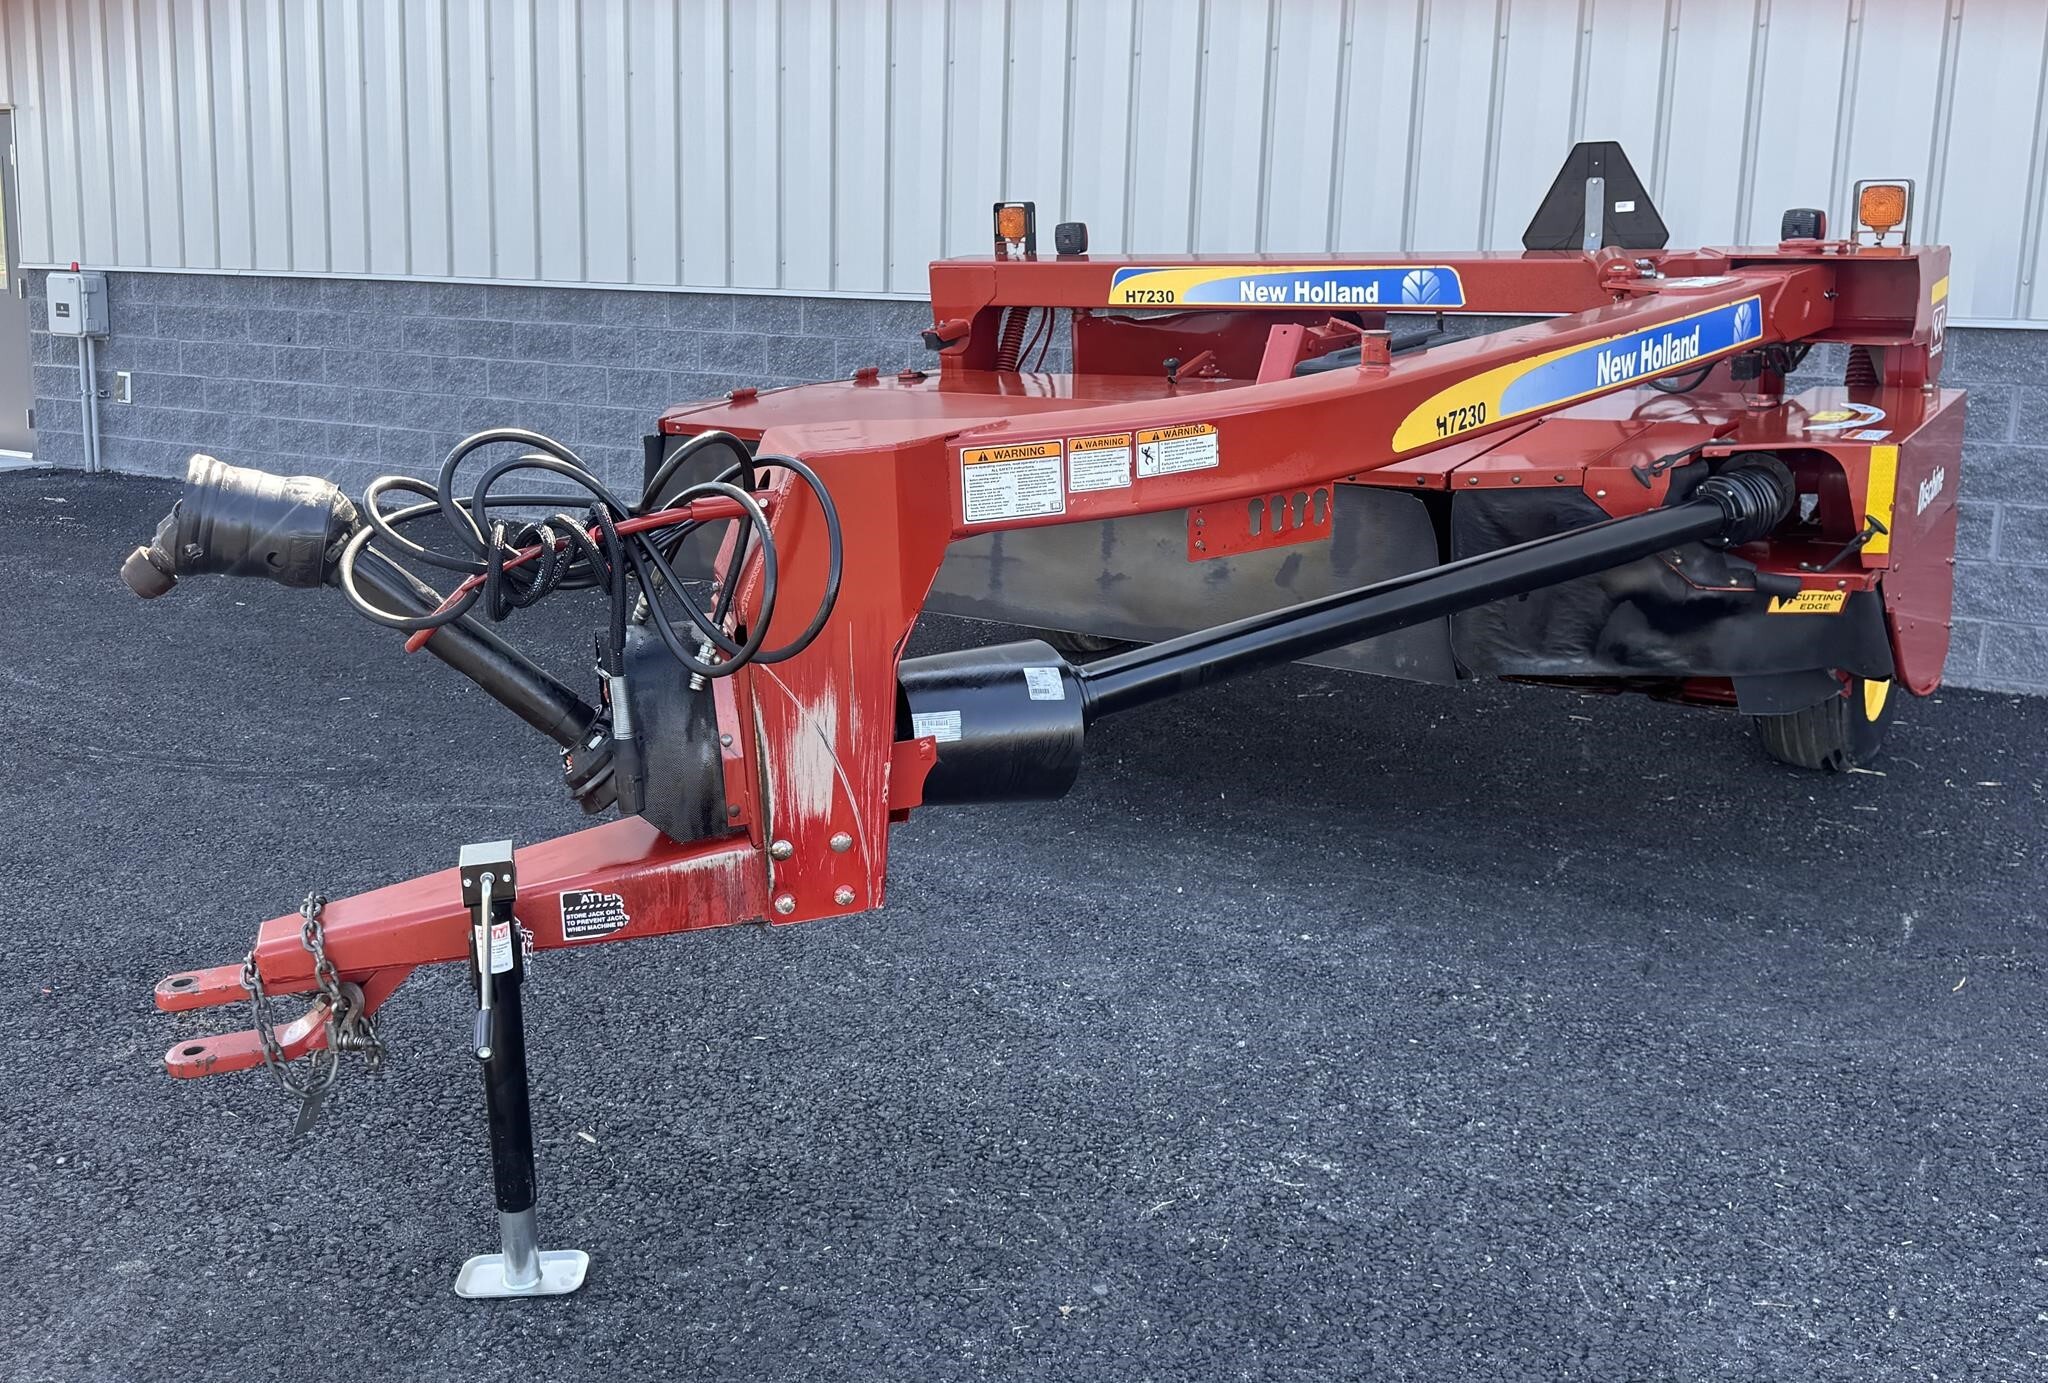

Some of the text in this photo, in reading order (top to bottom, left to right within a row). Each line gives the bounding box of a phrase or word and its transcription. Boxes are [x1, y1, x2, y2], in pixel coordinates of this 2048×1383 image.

[1125, 290, 1175, 303] H7230
[1240, 281, 1379, 303] New Holland
[1597, 324, 1700, 387] New Holland
[1436, 401, 1486, 438] H7230
[1163, 425, 1206, 438] WARNING
[1084, 438, 1124, 448] WARNING
[993, 446, 1046, 460] WARNING
[1795, 593, 1843, 601] CUTTING
[1799, 602, 1831, 610] EDGE
[566, 912, 587, 920] STORE
[576, 917, 606, 925] PREVENT
[567, 925, 587, 933] WHEN
[587, 922, 616, 930] MACHINE
